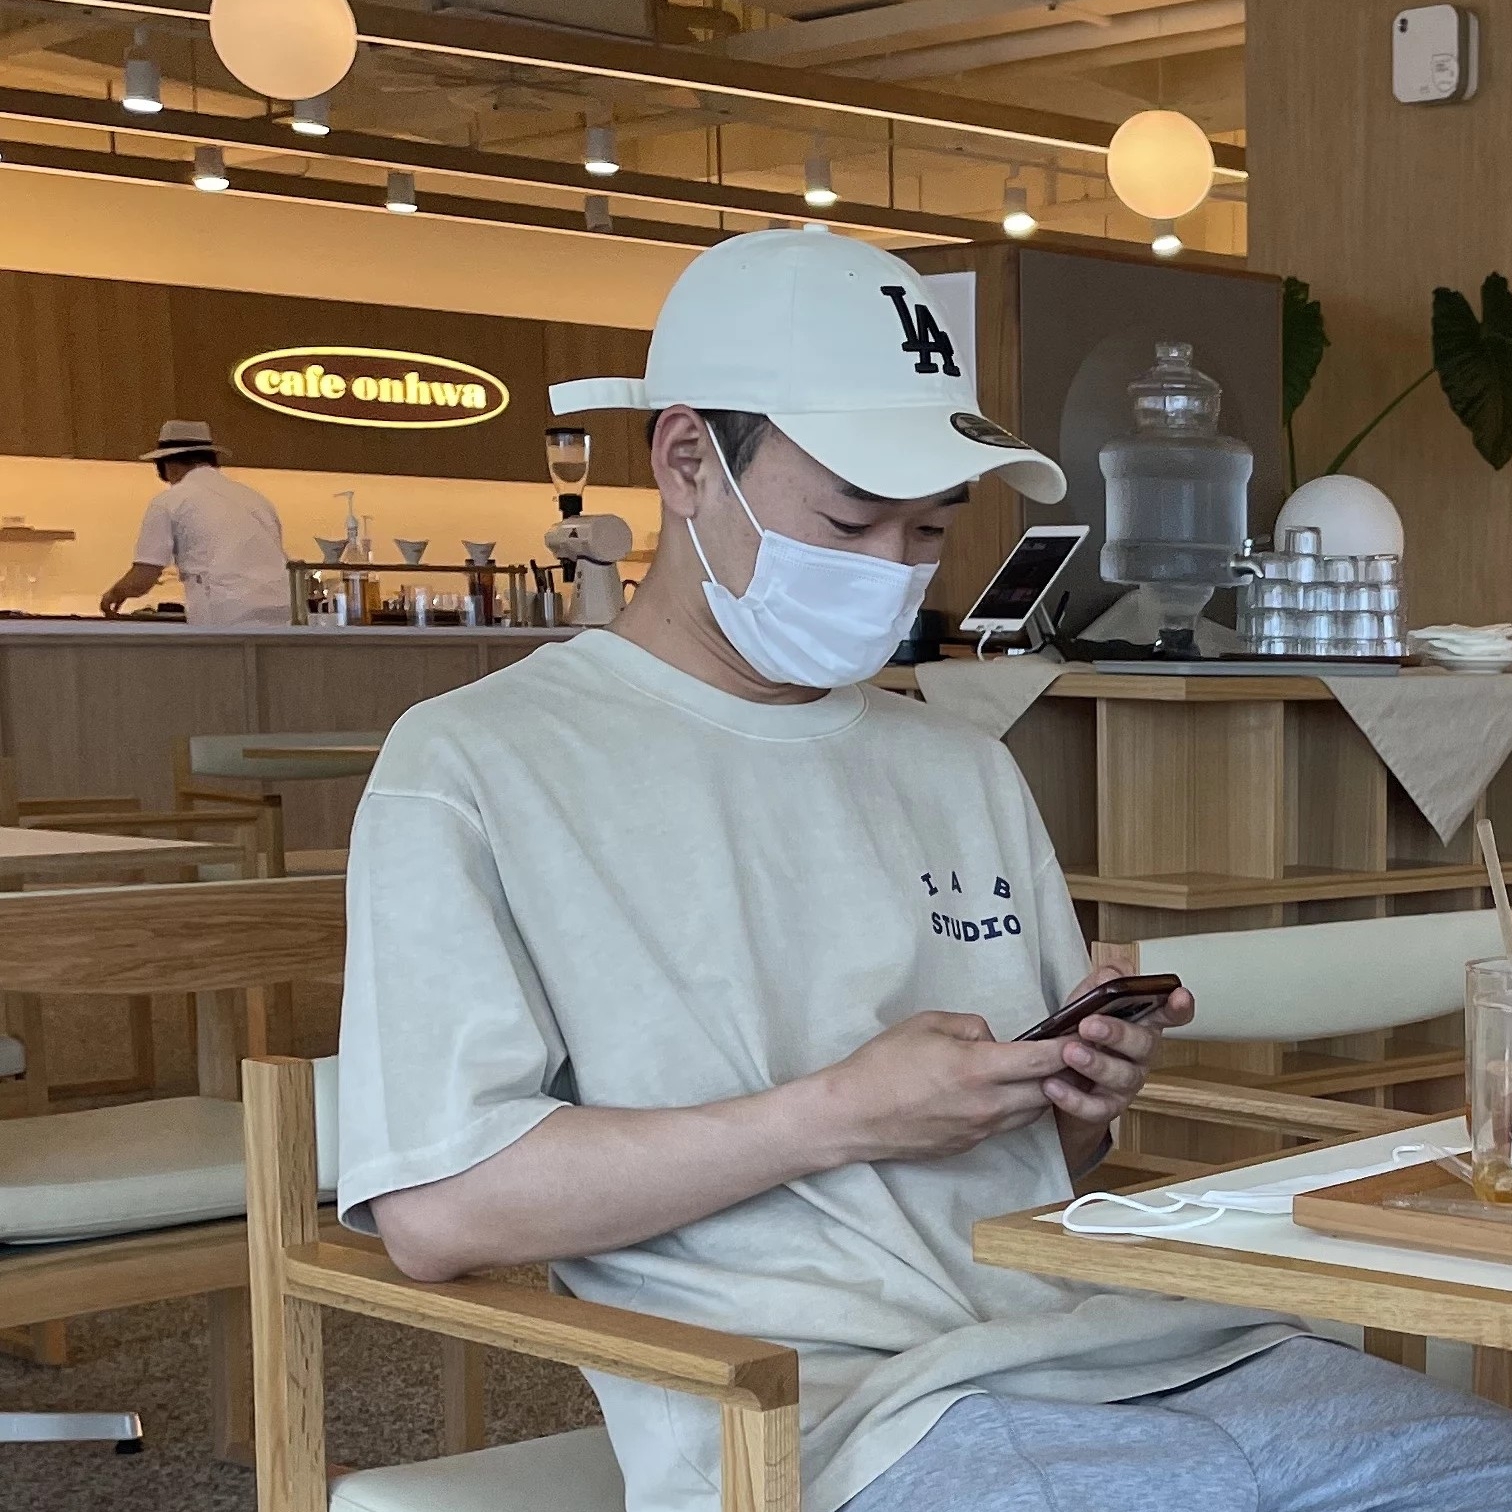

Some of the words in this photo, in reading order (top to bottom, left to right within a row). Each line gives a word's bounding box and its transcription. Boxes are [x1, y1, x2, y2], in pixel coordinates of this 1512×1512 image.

[880, 285, 961, 377] LA
[254, 364, 347, 399] cafe
[351, 371, 487, 409] onhwa
[931, 911, 1022, 942] STUDIO
